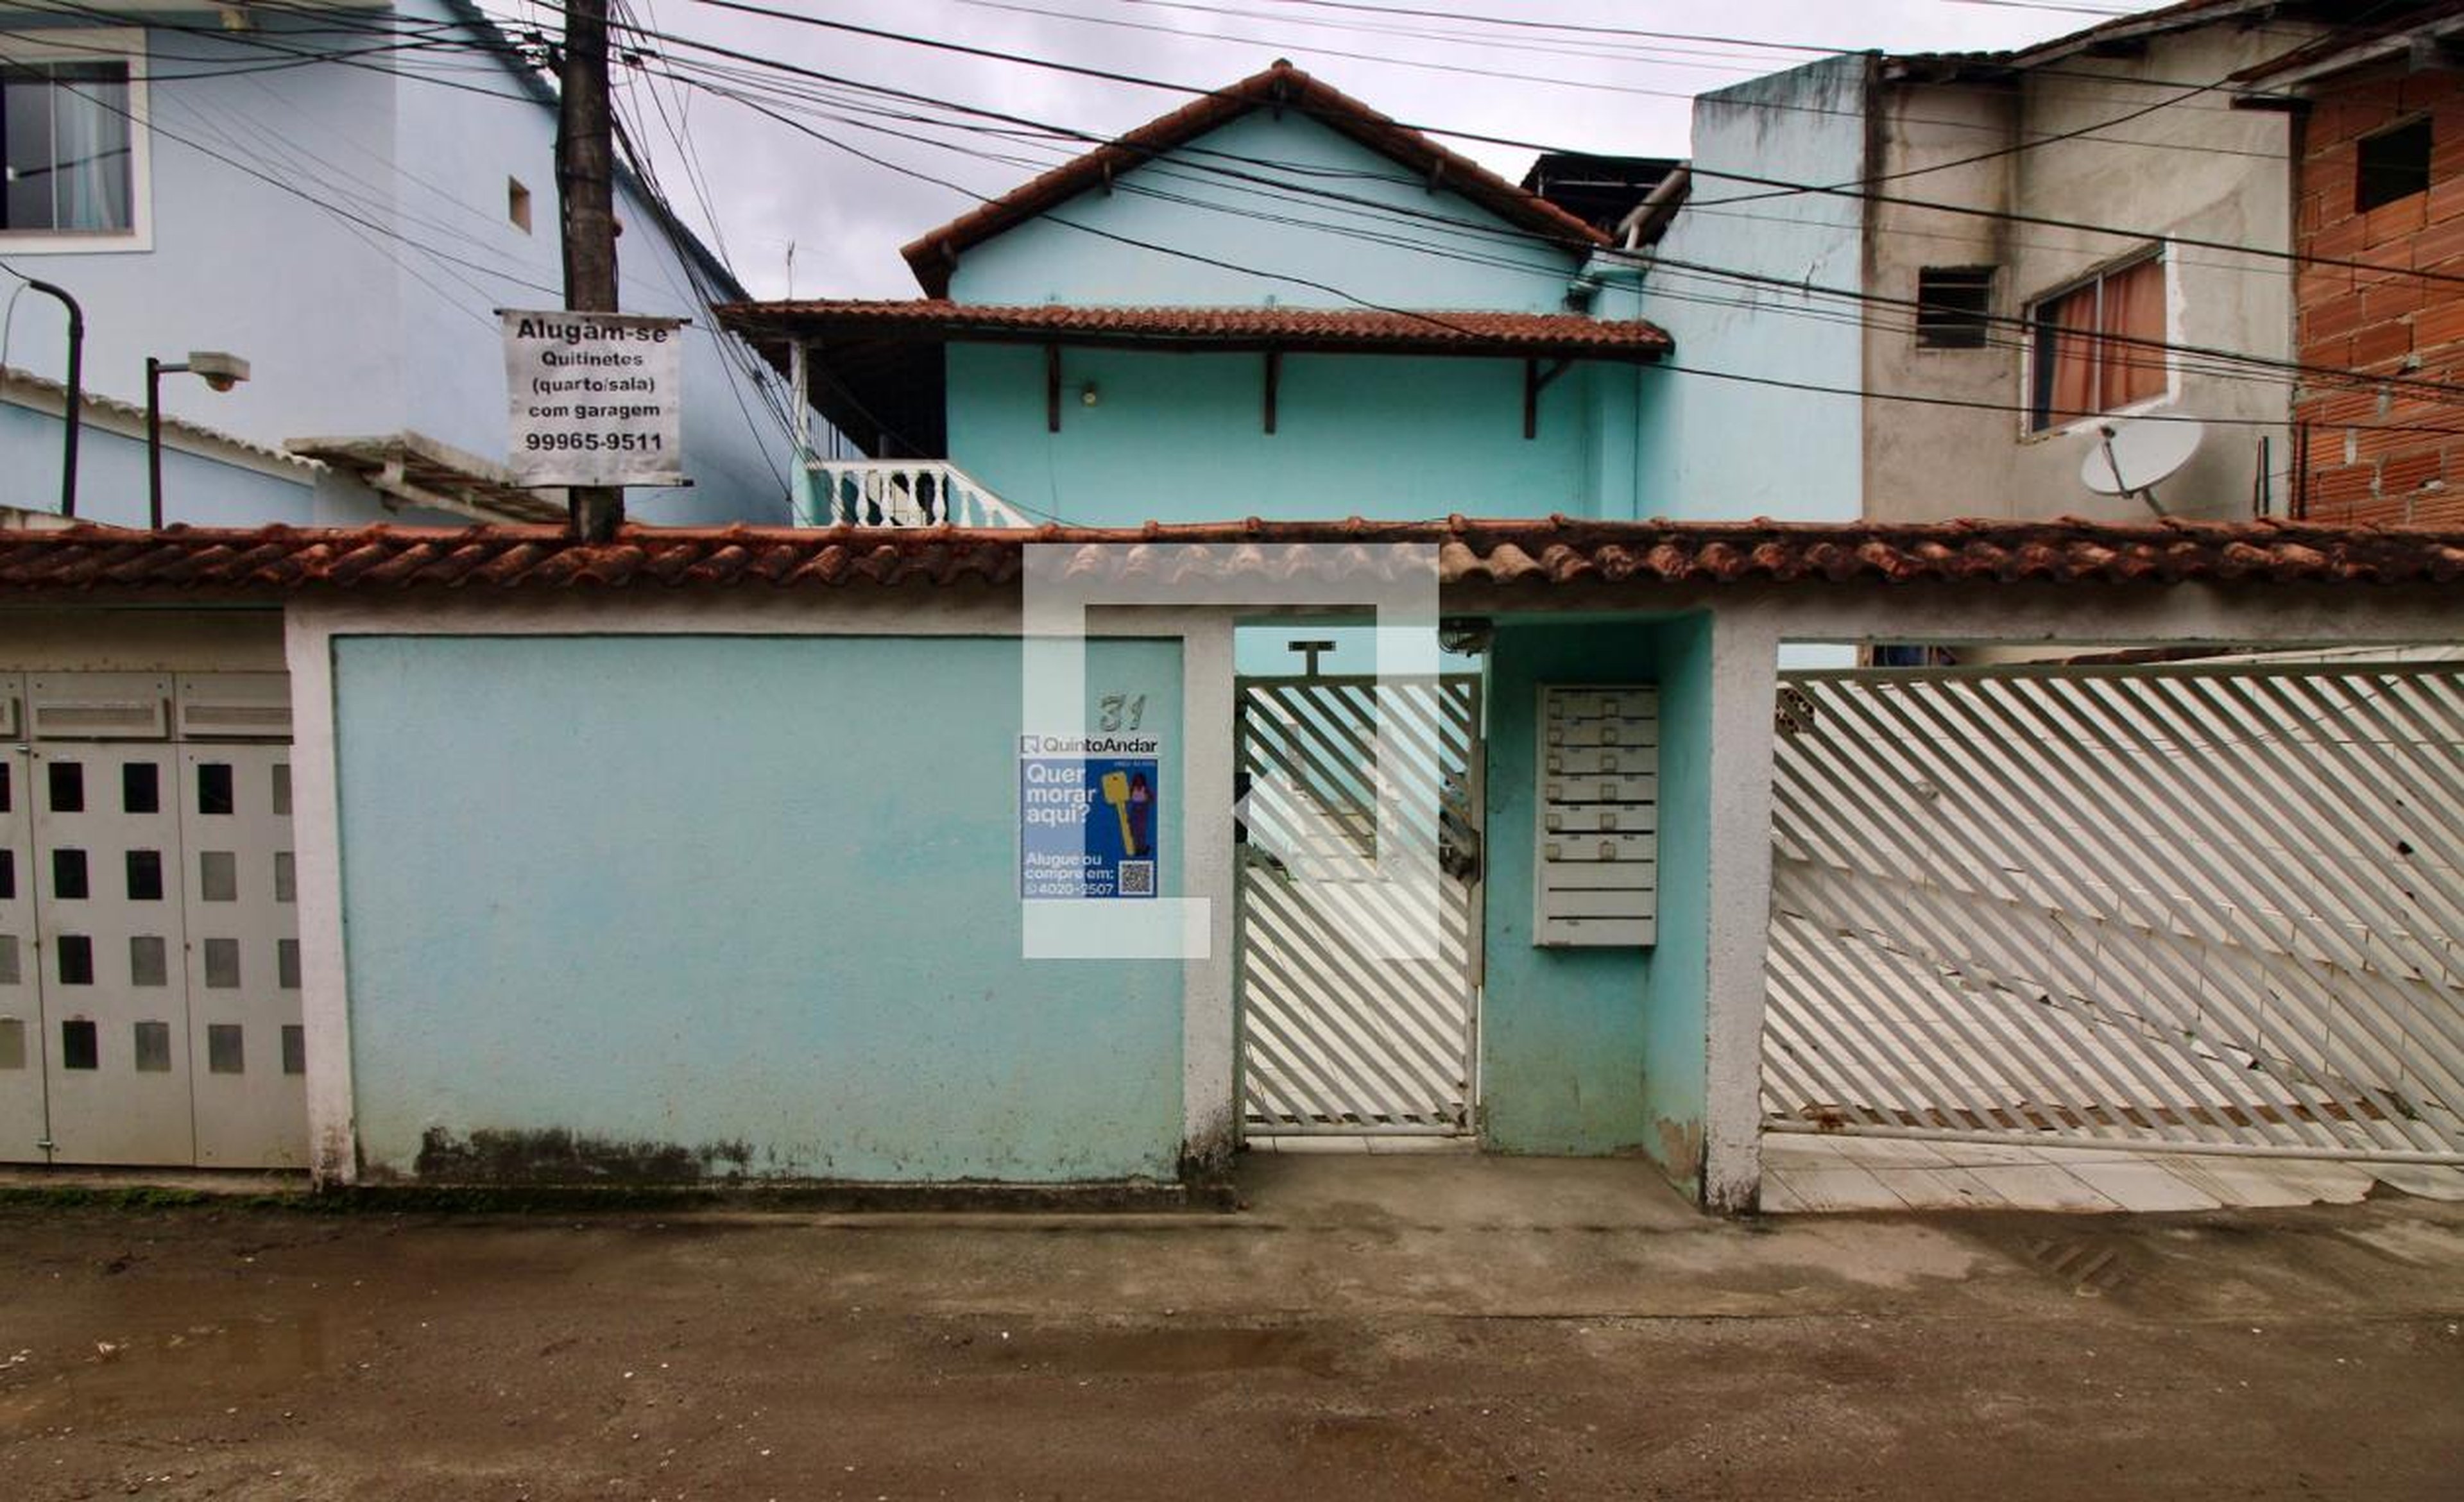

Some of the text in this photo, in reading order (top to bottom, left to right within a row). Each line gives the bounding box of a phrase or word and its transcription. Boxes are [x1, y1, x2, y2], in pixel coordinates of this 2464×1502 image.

[541, 351, 644, 366] Quitinetes
[532, 377, 654, 395] (quarto/sala)
[529, 405, 661, 420] com garagem
[525, 432, 662, 451] 99965-9511
[1100, 694, 1146, 732] 31
[1043, 737, 1158, 754] QuintoAndar
[1027, 764, 1085, 784] Quer
[1027, 788, 1096, 803] morar
[1027, 804, 1090, 827] aqui?
[1025, 852, 1102, 868] Alugue ou
[1025, 868, 1114, 880] compre em:
[1040, 883, 1114, 895] 4020-2507
